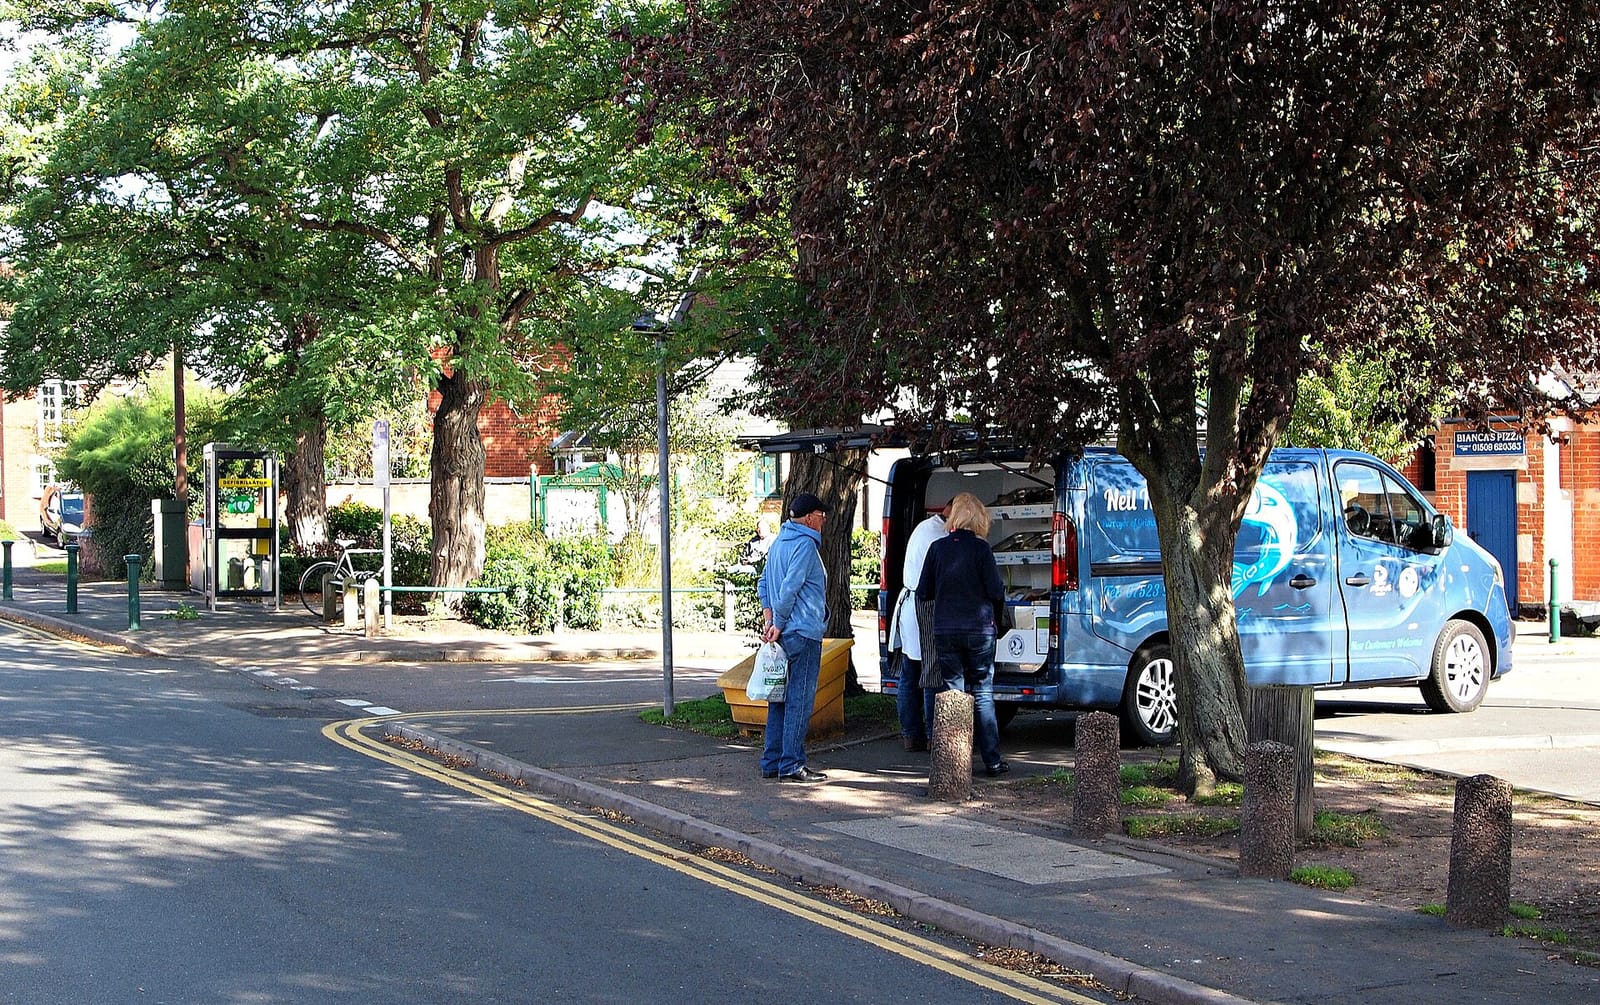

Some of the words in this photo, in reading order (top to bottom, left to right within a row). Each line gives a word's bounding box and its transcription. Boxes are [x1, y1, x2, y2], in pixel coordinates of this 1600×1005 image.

[1472, 443, 1493, 451] 01509
[562, 476, 586, 484] QUORN
[1104, 488, 1137, 512] Neil
[1126, 583, 1160, 598] 07523
[1396, 637, 1424, 648] Welcome
